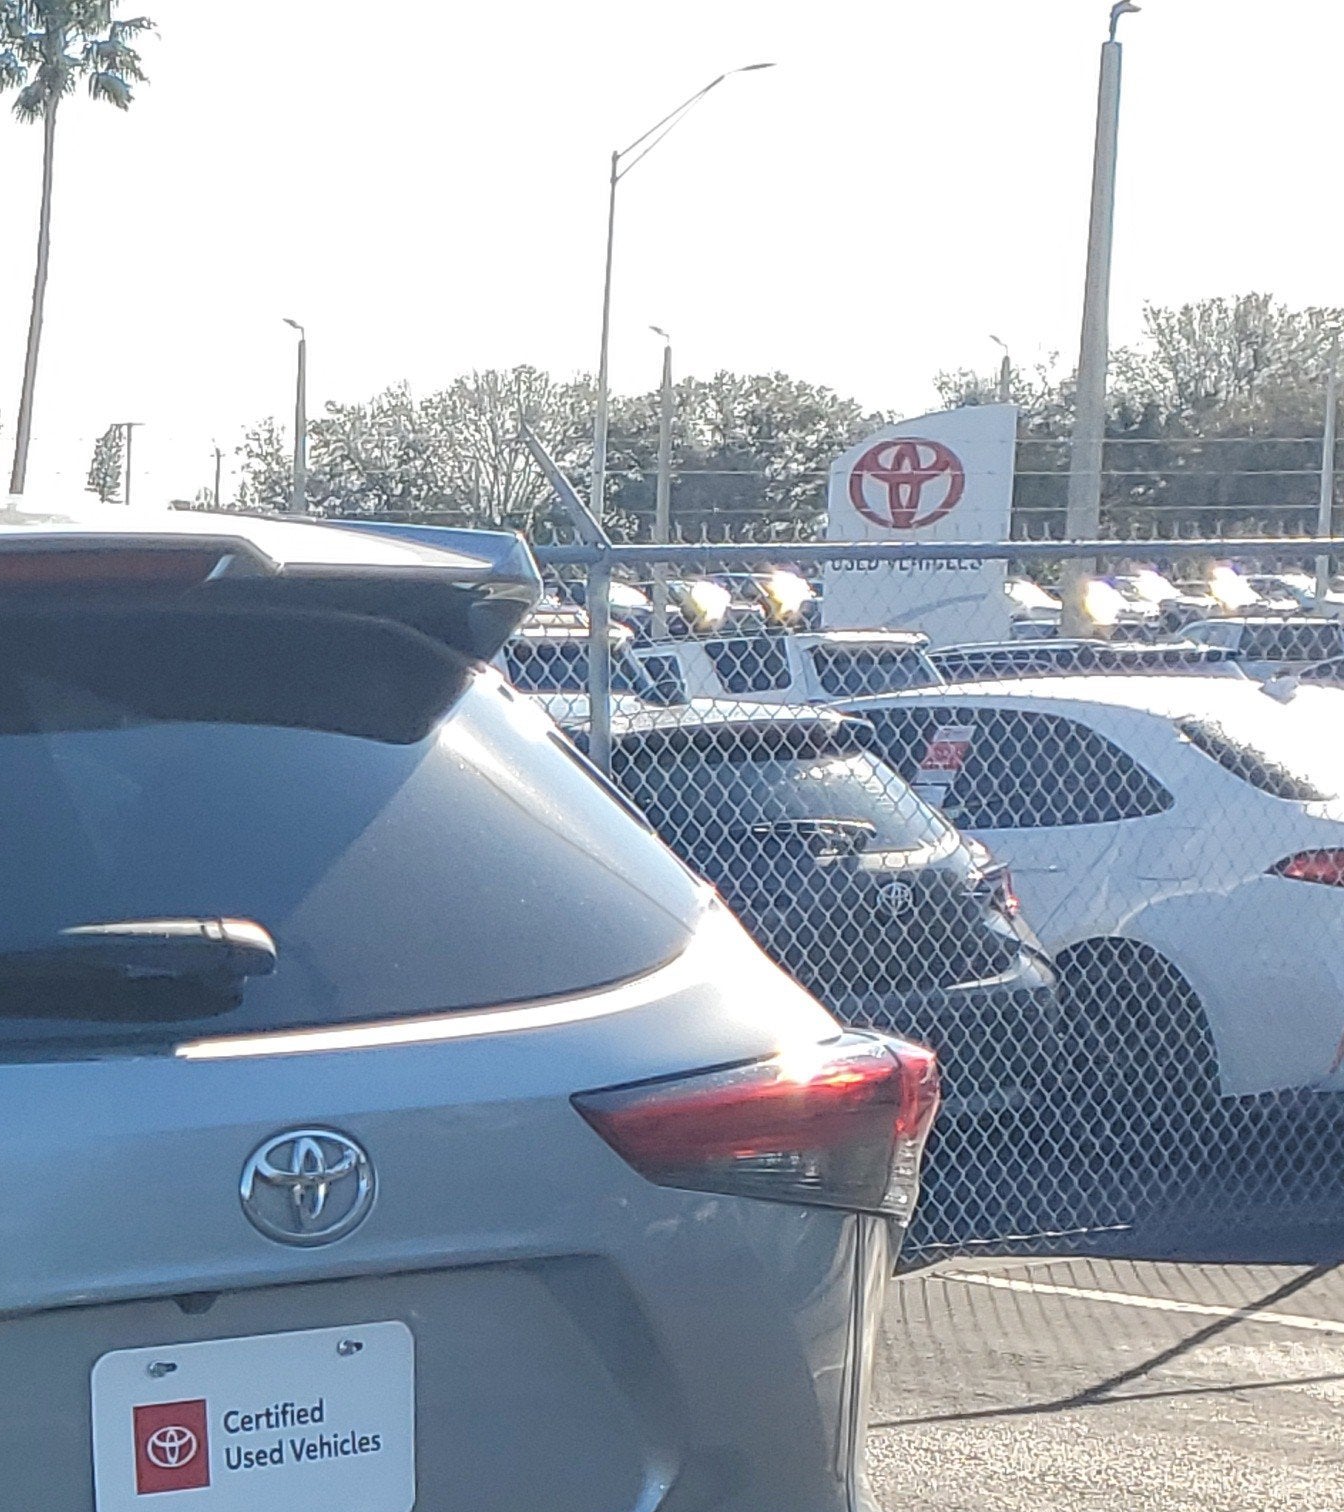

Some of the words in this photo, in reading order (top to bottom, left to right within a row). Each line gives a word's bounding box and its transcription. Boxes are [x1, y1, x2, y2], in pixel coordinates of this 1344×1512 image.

[223, 1397, 324, 1434] Certified
[225, 1439, 284, 1470] Used
[289, 1430, 382, 1463] Vehicles
